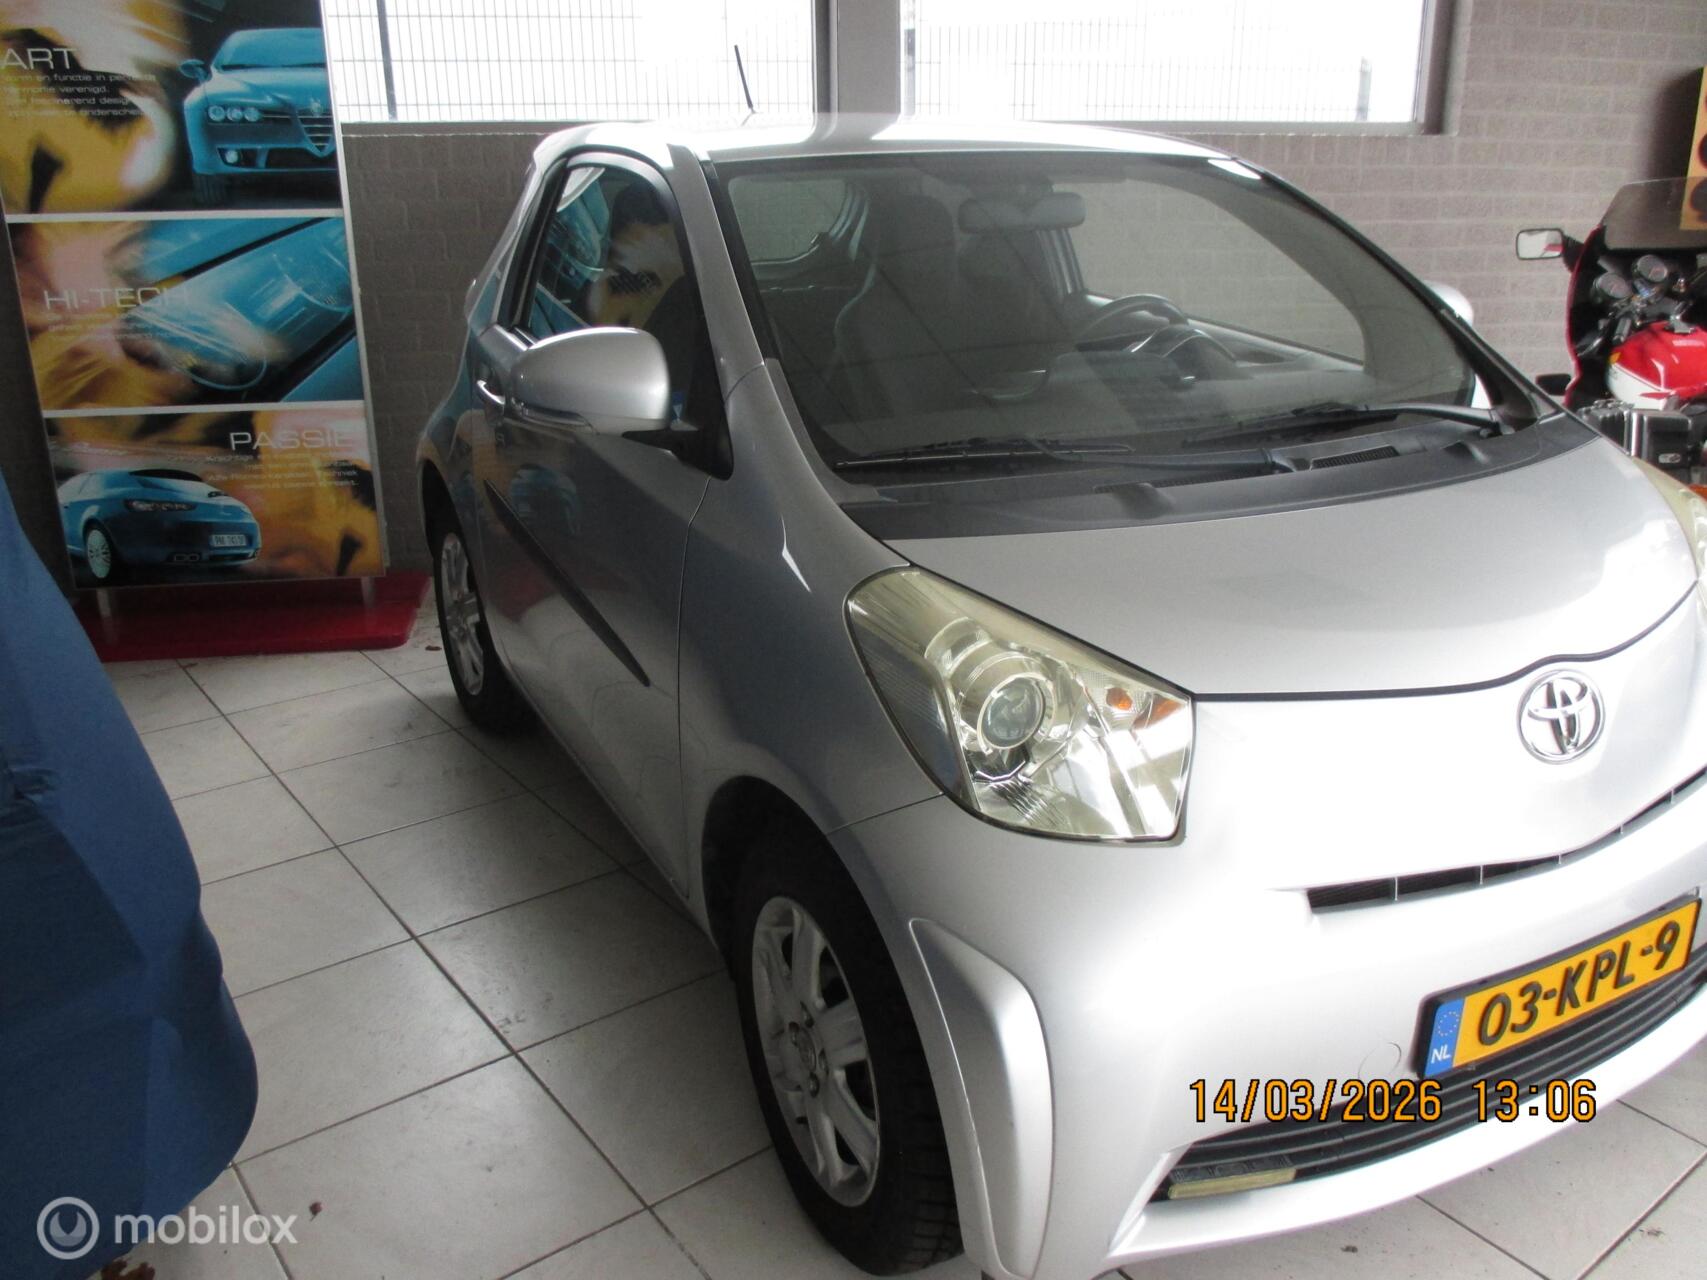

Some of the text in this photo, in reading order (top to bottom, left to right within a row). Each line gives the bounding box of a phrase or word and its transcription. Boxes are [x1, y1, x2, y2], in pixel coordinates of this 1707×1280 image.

[0, 47, 76, 70] ART
[53, 73, 92, 81] functie
[229, 430, 353, 451] PASSIE
[1478, 920, 1681, 1046] 03-KPL-9
[1430, 1044, 1453, 1064] NL
